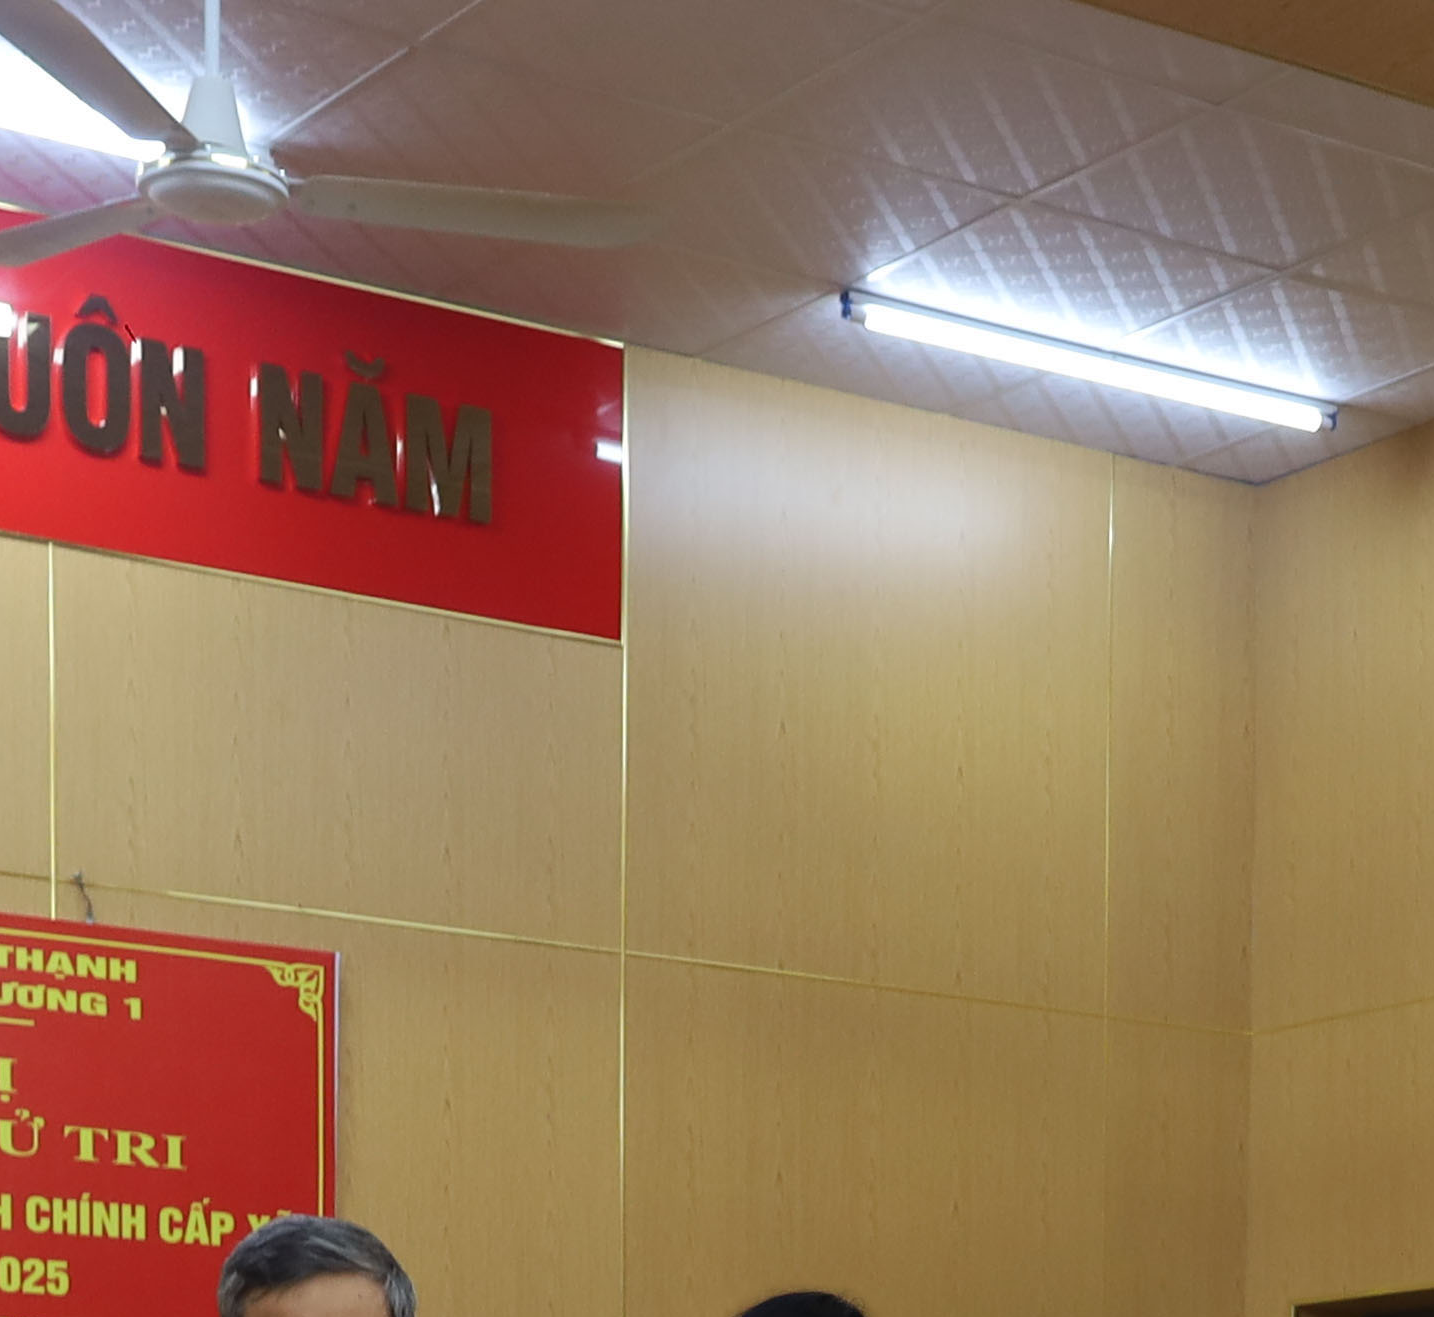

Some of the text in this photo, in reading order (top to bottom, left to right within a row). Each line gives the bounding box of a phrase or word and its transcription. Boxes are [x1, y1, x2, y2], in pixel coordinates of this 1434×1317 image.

[253, 350, 492, 524] NĂM
[124, 997, 142, 1020] 1
[64, 1126, 183, 1169] TRI
[25, 1193, 146, 1240] CHÍNH
[159, 1198, 234, 1246] CẤP
